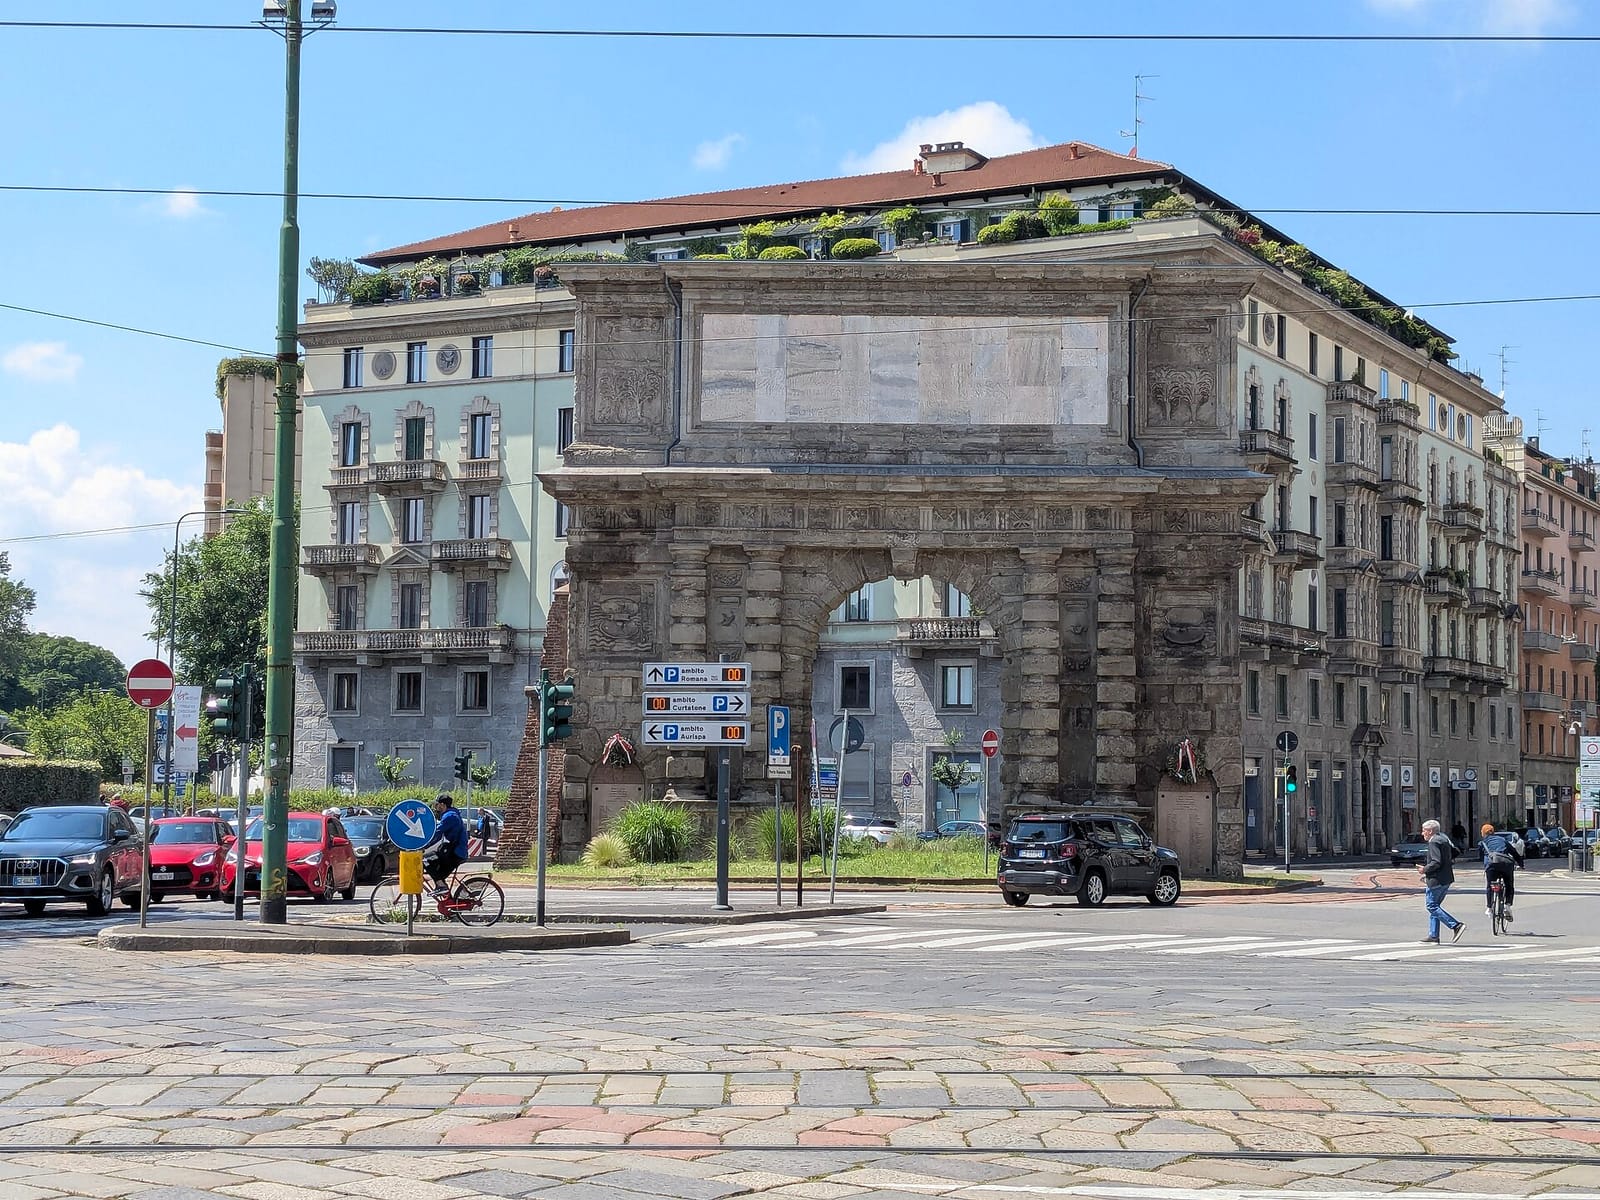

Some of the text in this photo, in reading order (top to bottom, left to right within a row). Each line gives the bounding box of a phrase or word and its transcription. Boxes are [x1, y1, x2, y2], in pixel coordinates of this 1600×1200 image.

[667, 669, 677, 681] P
[727, 668, 741, 681] 00
[652, 697, 666, 710] 00
[716, 698, 725, 710] P
[773, 710, 786, 739] P
[666, 727, 676, 739] P
[726, 726, 740, 739] 00
